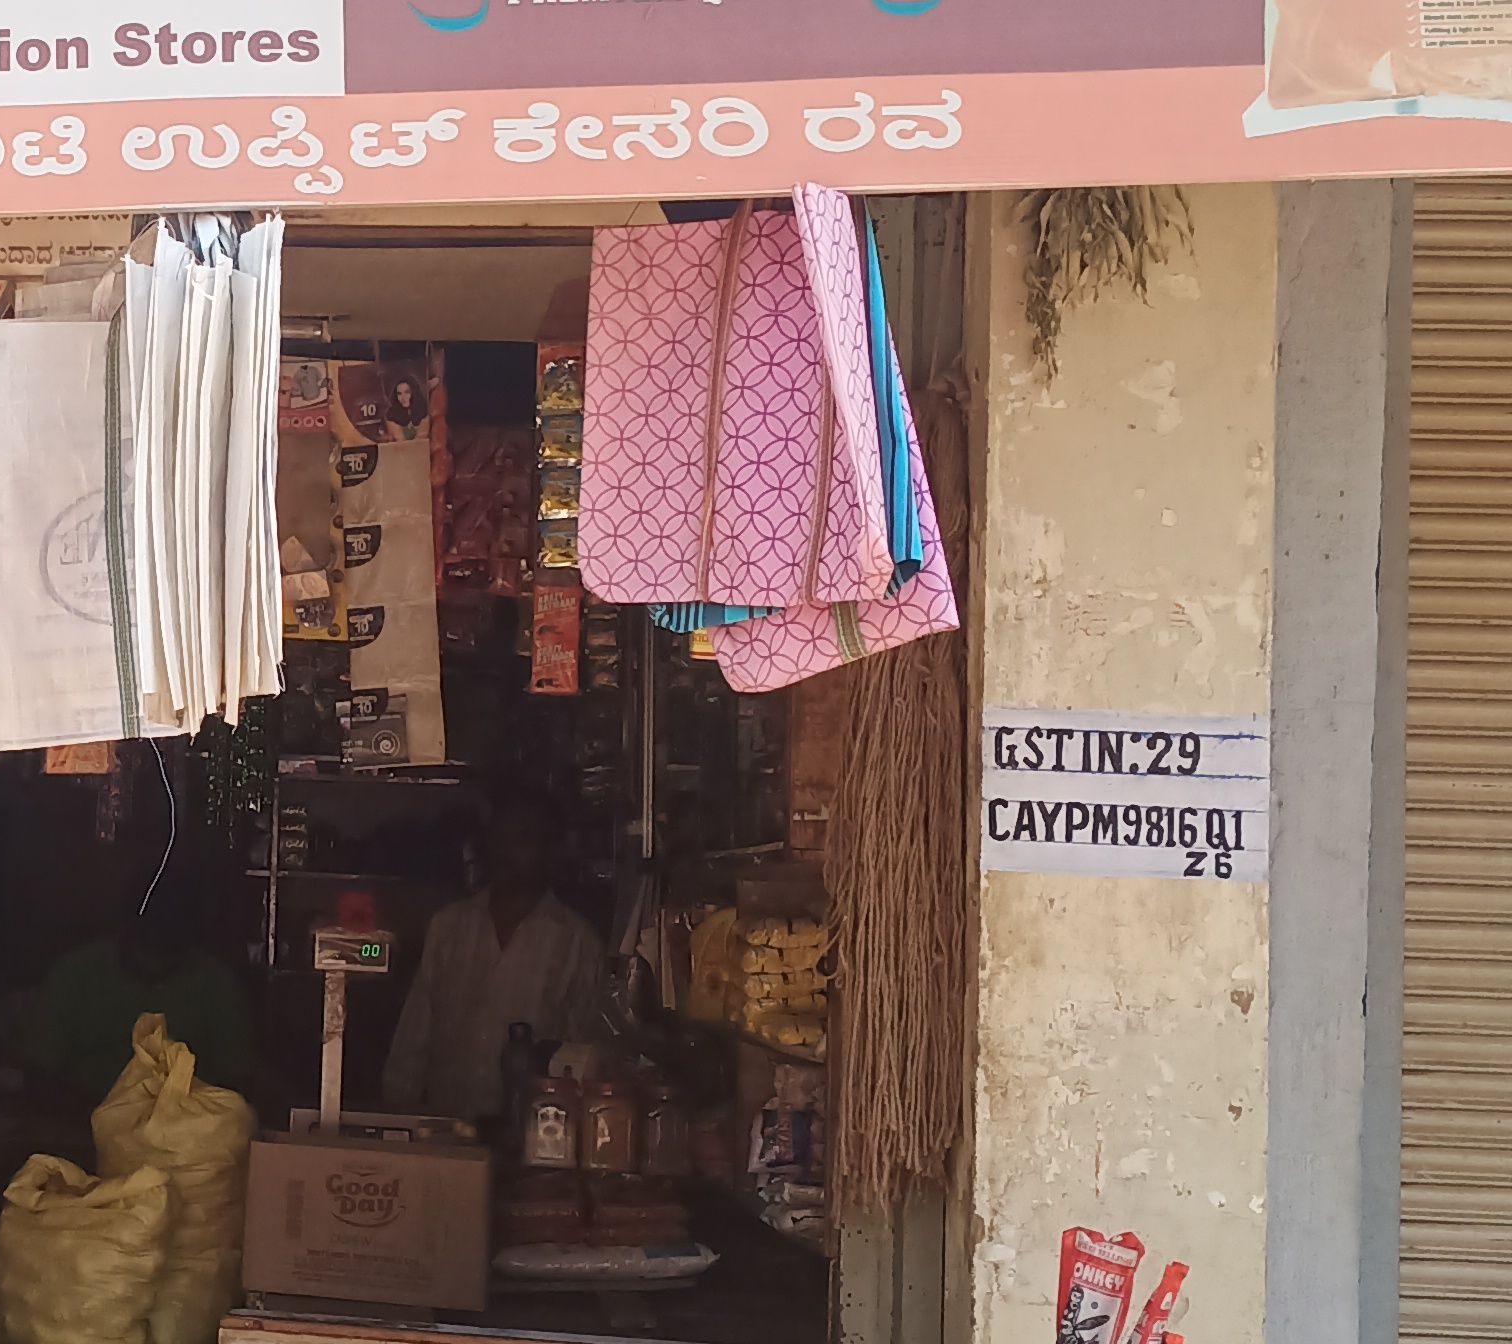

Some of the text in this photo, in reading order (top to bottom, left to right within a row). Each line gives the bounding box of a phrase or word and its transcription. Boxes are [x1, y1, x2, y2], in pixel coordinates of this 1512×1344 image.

[112, 21, 321, 68] Stores
[120, 105, 467, 197] ಉಪ್ಪಿಟ್
[492, 96, 770, 164] ಕೇಸರಿ
[802, 89, 964, 154] ರವ
[360, 403, 377, 417] 10
[325, 1173, 401, 1198] Good
[335, 1195, 395, 1220] Day
